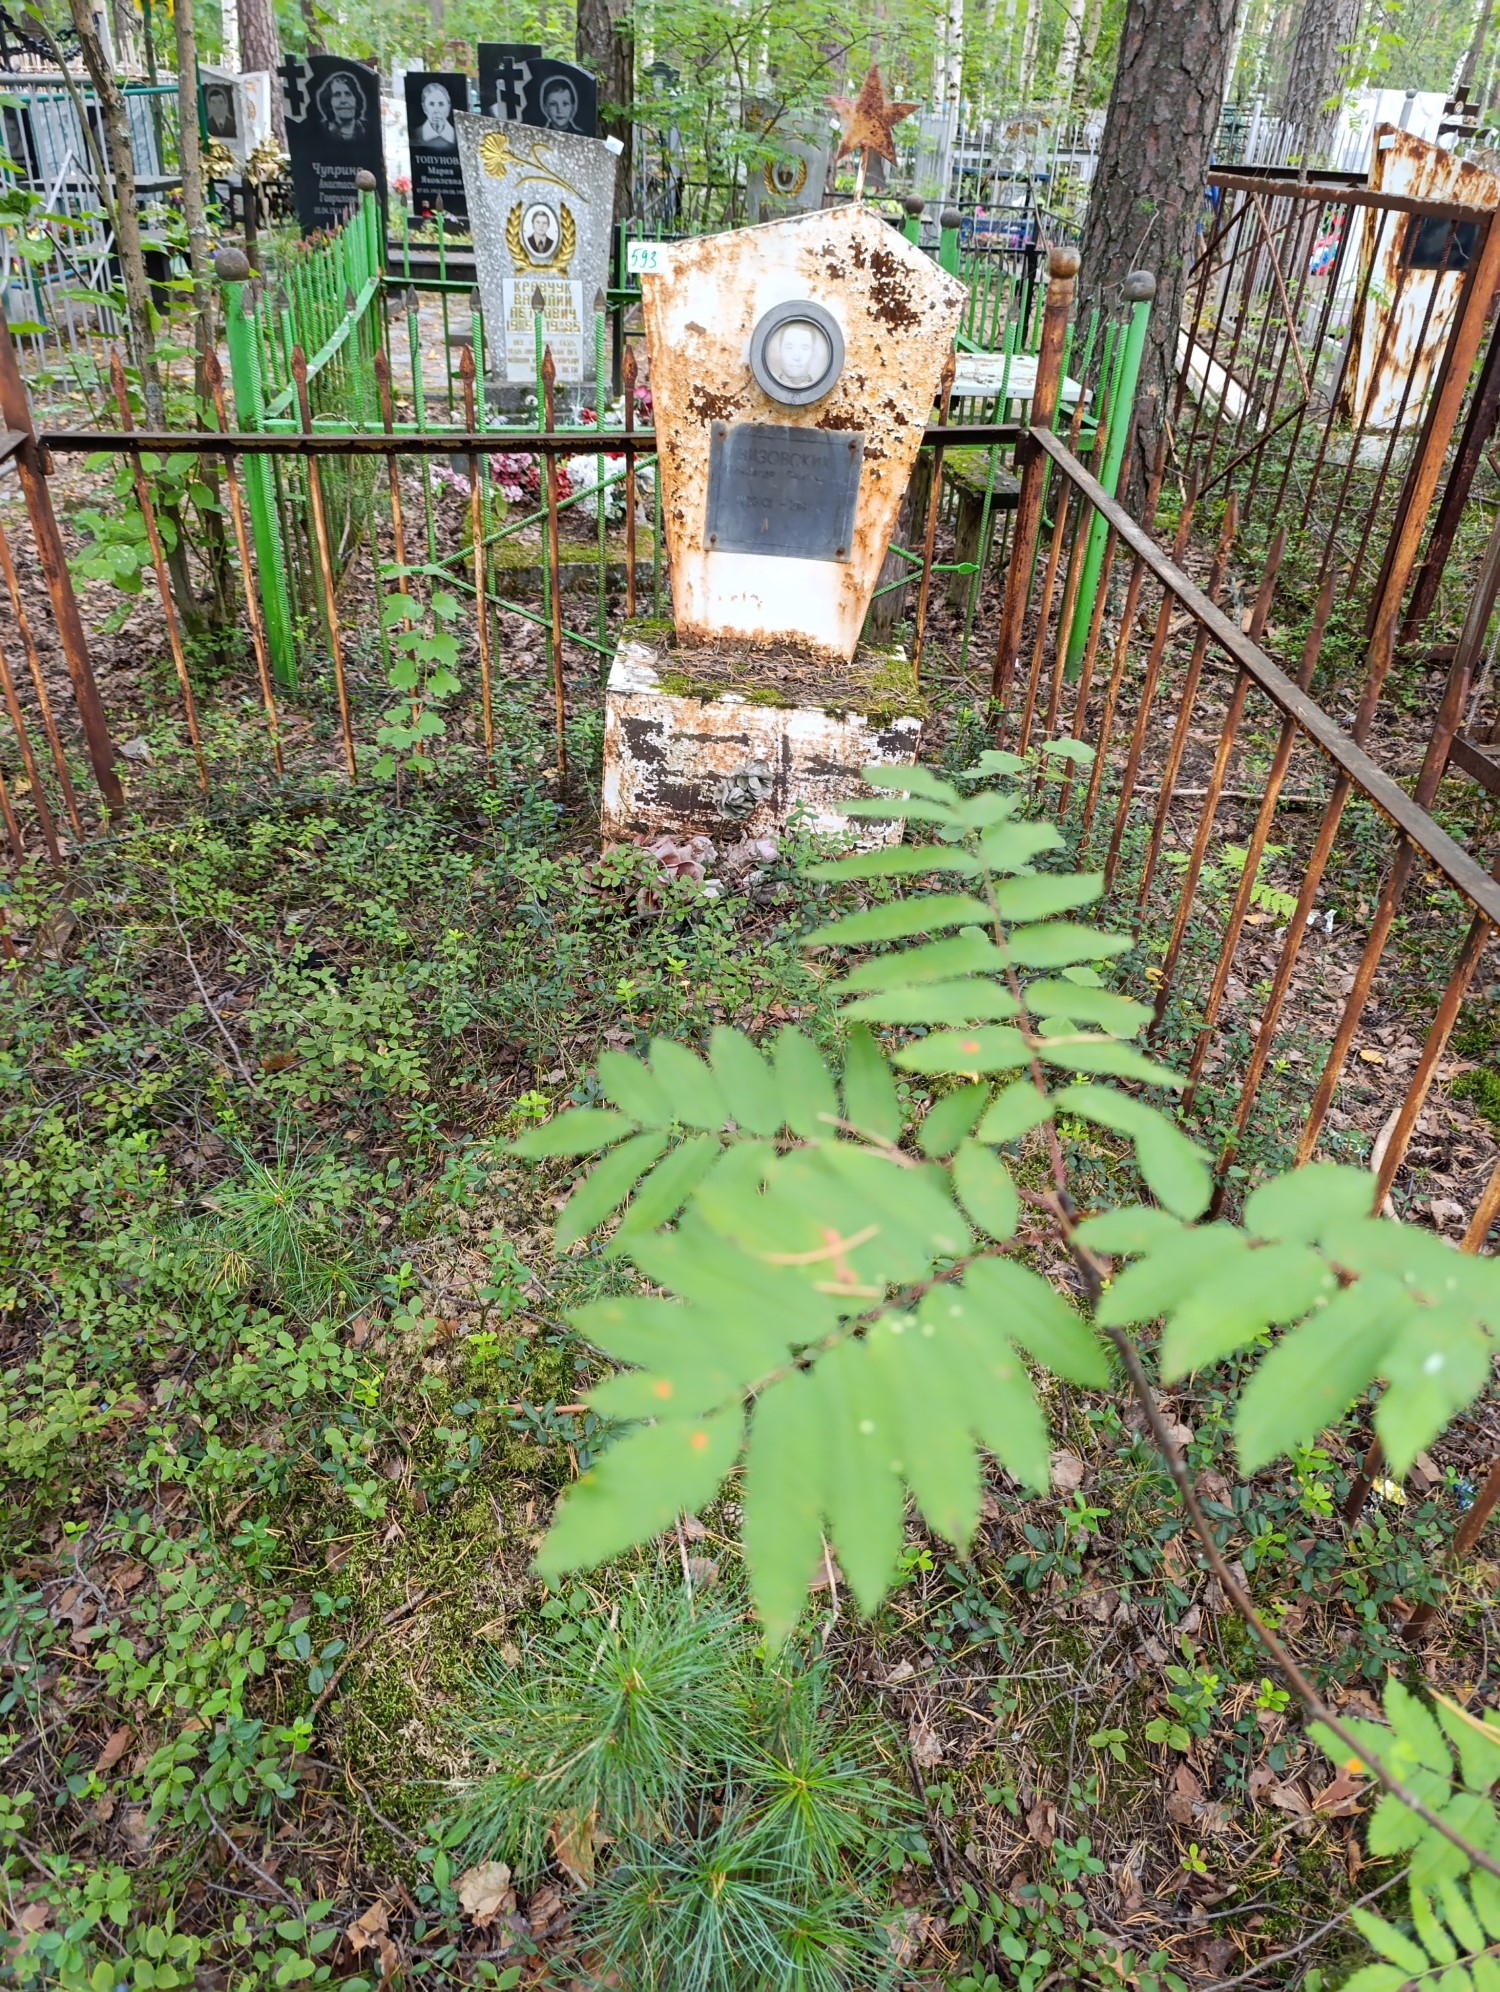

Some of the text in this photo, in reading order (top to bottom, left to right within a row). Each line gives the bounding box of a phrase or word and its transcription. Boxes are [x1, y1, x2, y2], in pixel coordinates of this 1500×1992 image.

[415, 155, 460, 165] ТОПУНОВ
[427, 166, 454, 177] Мария
[421, 175, 463, 186] Яковлевна
[631, 247, 657, 268] 593
[514, 281, 571, 294] КРАВЧУК
[510, 307, 576, 320] ПЕТОВИЧ
